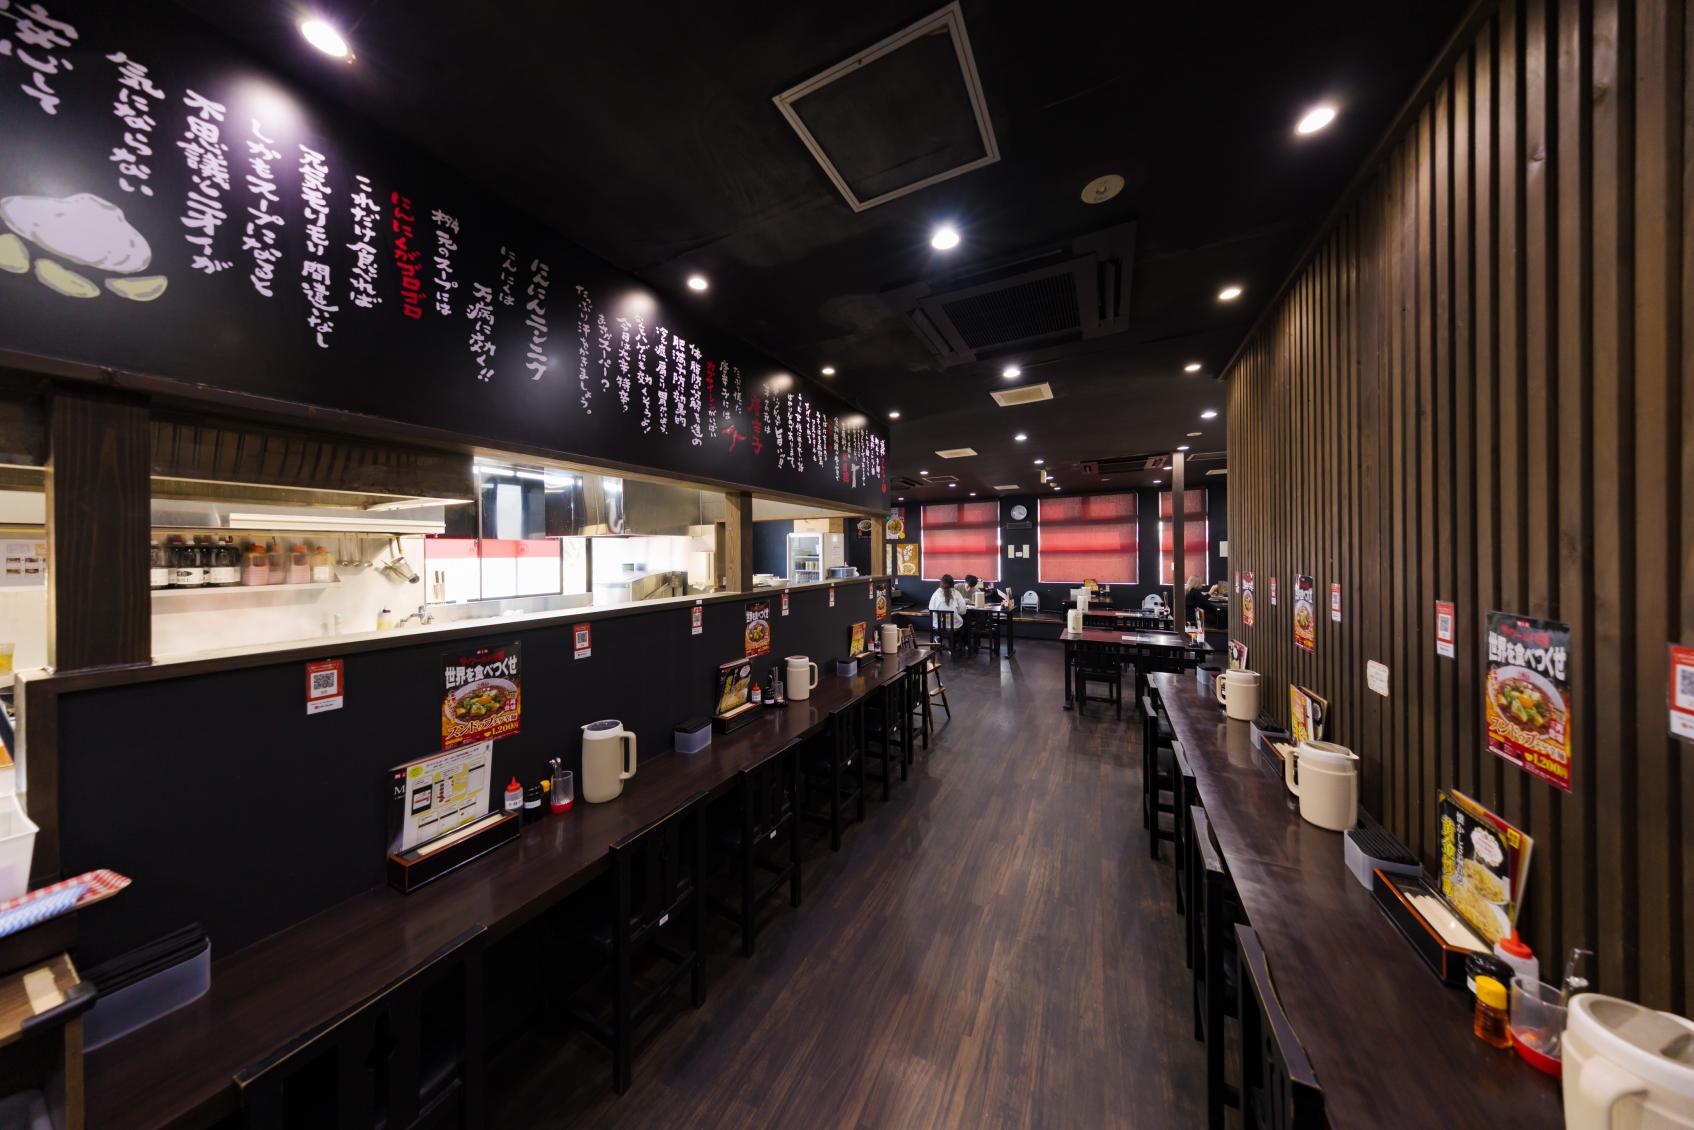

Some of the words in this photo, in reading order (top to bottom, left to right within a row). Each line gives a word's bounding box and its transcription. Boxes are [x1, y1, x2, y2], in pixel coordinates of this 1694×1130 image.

[106, 52, 165, 196] 気にならない
[176, 89, 233, 274] 不思議とニオイが
[242, 117, 285, 297] しかもスープになると
[299, 146, 331, 256] 元気モリモリ
[346, 175, 382, 308] これだけ食べれば
[391, 192, 426, 319] にんにくがゴロゴロ
[301, 260, 339, 348] 間違いなし
[499, 247, 516, 305] にんにくは
[526, 260, 550, 380] にんにんニンニク
[672, 335, 686, 427] 肥満予防に効果的
[445, 655, 517, 689] 世界を食べつくせ
[1488, 631, 1566, 681] 世界を食べつくせ
